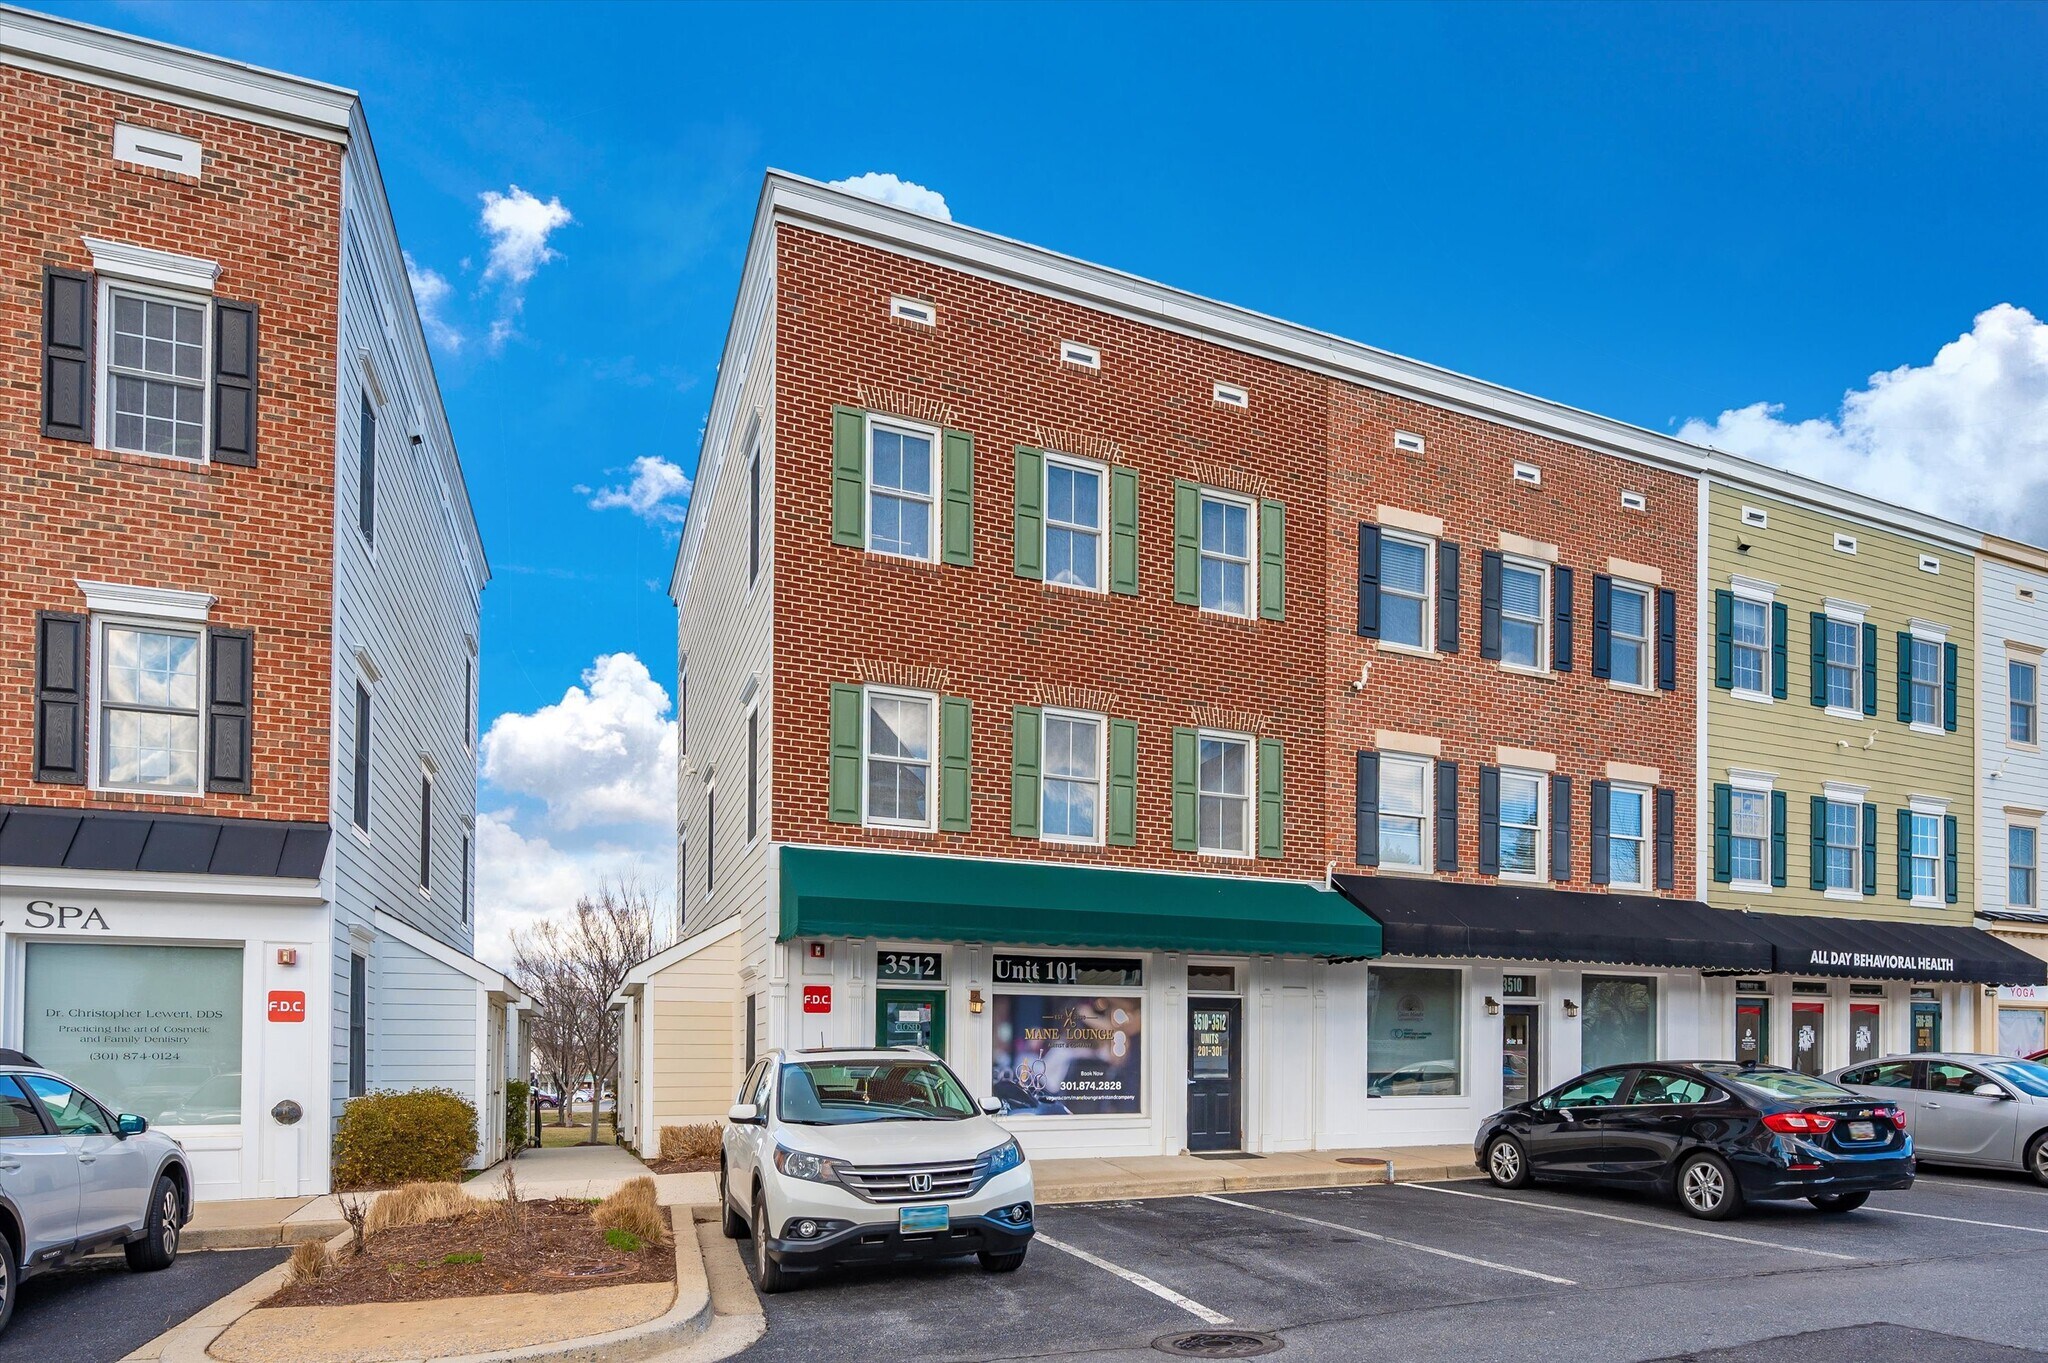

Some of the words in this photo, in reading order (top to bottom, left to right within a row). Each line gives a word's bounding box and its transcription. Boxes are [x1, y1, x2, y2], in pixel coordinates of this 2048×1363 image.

[25, 900, 111, 930] SPA
[885, 954, 936, 976] 3512
[1810, 950, 1829, 965] ALL
[1830, 951, 1852, 966] DAY
[1853, 953, 1917, 970] BEHAVIORAL
[1917, 957, 1954, 971] HEALTH
[995, 959, 1040, 982] Unit
[1046, 961, 1077, 981] 101
[1503, 977, 1522, 993] 3510
[2010, 988, 2035, 998] YOGA
[804, 995, 831, 1005] F.D.C.
[269, 1001, 304, 1012] F.D.C.
[46, 1008, 64, 1018] Dr.
[68, 1008, 142, 1019] Christopher
[146, 1010, 193, 1019] Lewert,
[196, 1010, 224, 1019] DDS
[895, 1022, 921, 1031] CLOSED
[1193, 1013, 1227, 1031] 3510-3512
[58, 1025, 111, 1034] Practicing
[149, 1025, 161, 1033] of
[163, 1026, 211, 1034] Cosmetic
[1024, 1028, 1060, 1040] MANE
[1066, 1028, 1115, 1041] LOUNGE
[104, 1036, 141, 1044] Family
[144, 1036, 190, 1045] Dentistry
[1200, 1033, 1219, 1044] UNITS
[1197, 1045, 1223, 1057] 201-301
[90, 1052, 119, 1062] (301)
[122, 1052, 181, 1061] 874-0124
[1060, 1081, 1122, 1091] 301.874.2828
